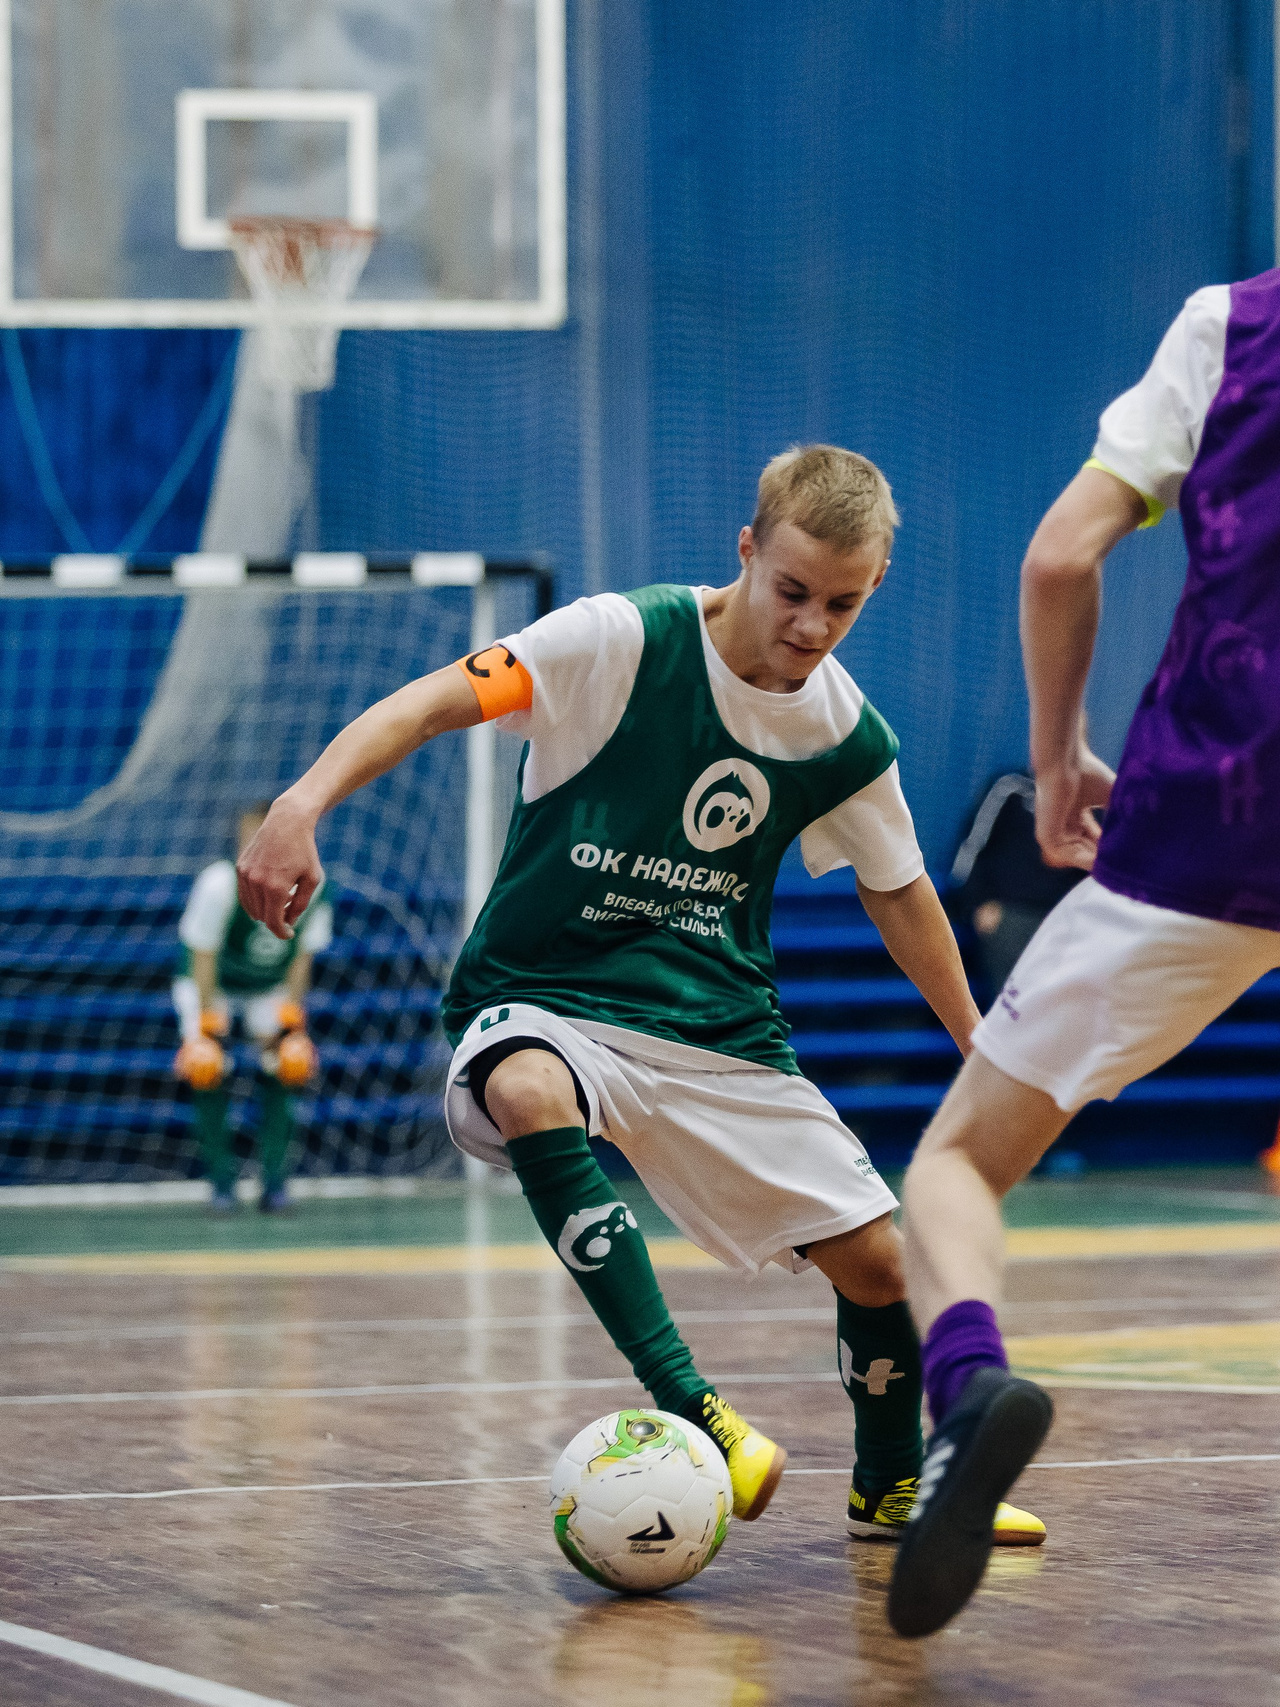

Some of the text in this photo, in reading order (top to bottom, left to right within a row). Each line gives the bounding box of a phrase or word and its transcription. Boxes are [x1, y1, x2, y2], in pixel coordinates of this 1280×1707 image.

[570, 843, 628, 874] ФК
[603, 892, 663, 918] ВПЕРЁД
[669, 917, 727, 939] СИЛЬН
